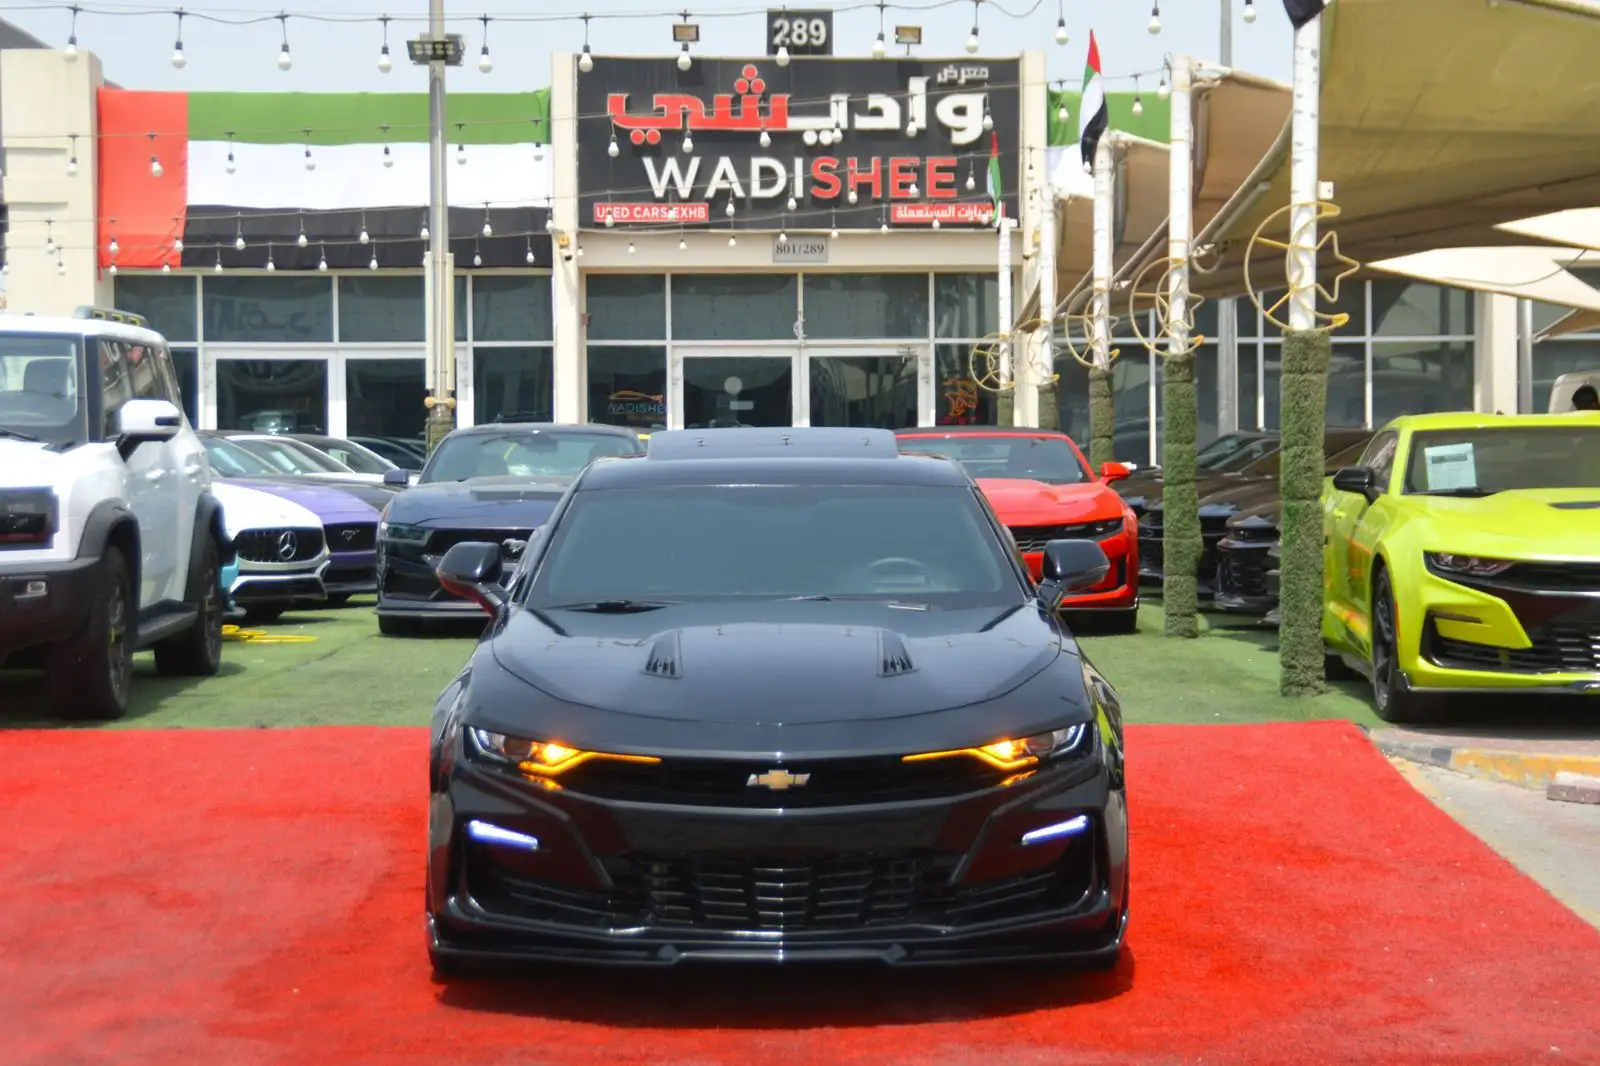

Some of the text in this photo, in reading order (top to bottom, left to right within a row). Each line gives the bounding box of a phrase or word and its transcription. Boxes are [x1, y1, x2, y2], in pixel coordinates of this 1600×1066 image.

[773, 18, 826, 46] 289
[937, 64, 989, 84] معرض
[642, 156, 957, 198] WADISHEE
[633, 206, 667, 218] CARS
[775, 243, 825, 255] 801/289
